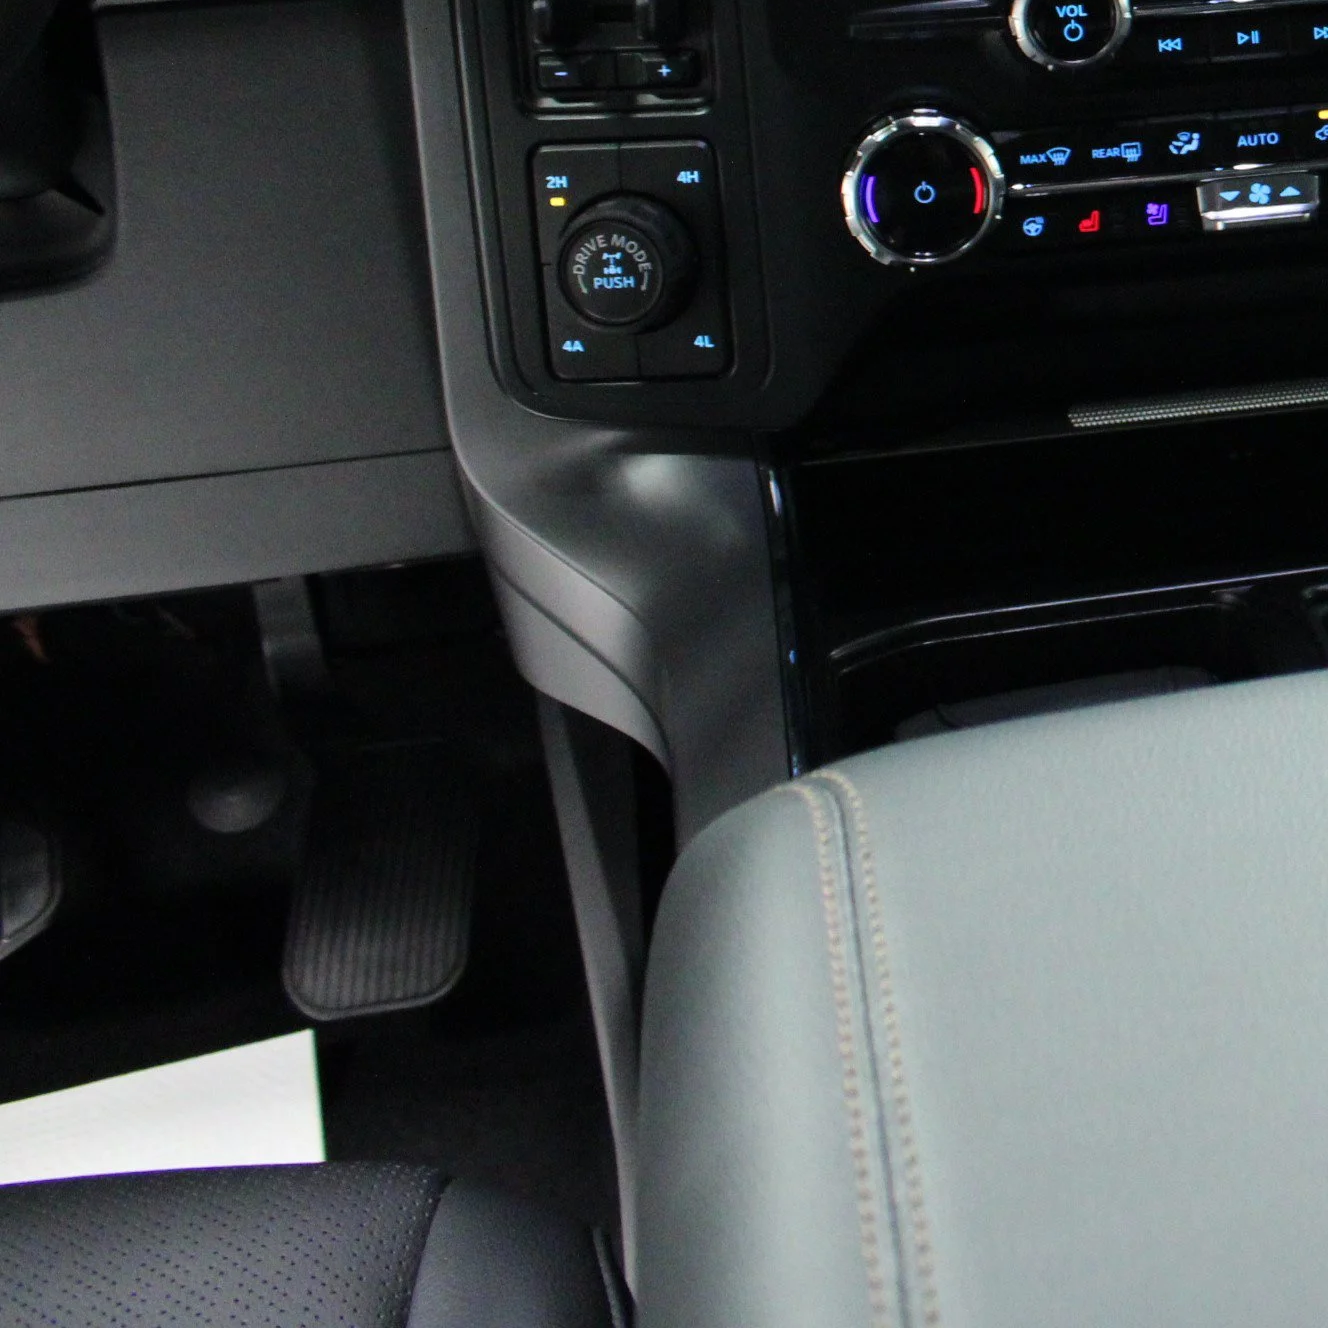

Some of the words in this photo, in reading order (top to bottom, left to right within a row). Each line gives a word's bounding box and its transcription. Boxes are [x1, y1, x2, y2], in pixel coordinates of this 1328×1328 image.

[1056, 5, 1088, 19] VOL
[1237, 132, 1279, 148] AUTO
[1020, 154, 1047, 166] MAX
[1092, 147, 1120, 160] REAR
[546, 175, 569, 190] 2H
[676, 170, 700, 184] 4H
[573, 234, 609, 276] DRIVE
[610, 233, 653, 273] MODE
[593, 276, 636, 290] PUSH
[562, 340, 585, 353] 4A
[693, 335, 716, 348] 4L
